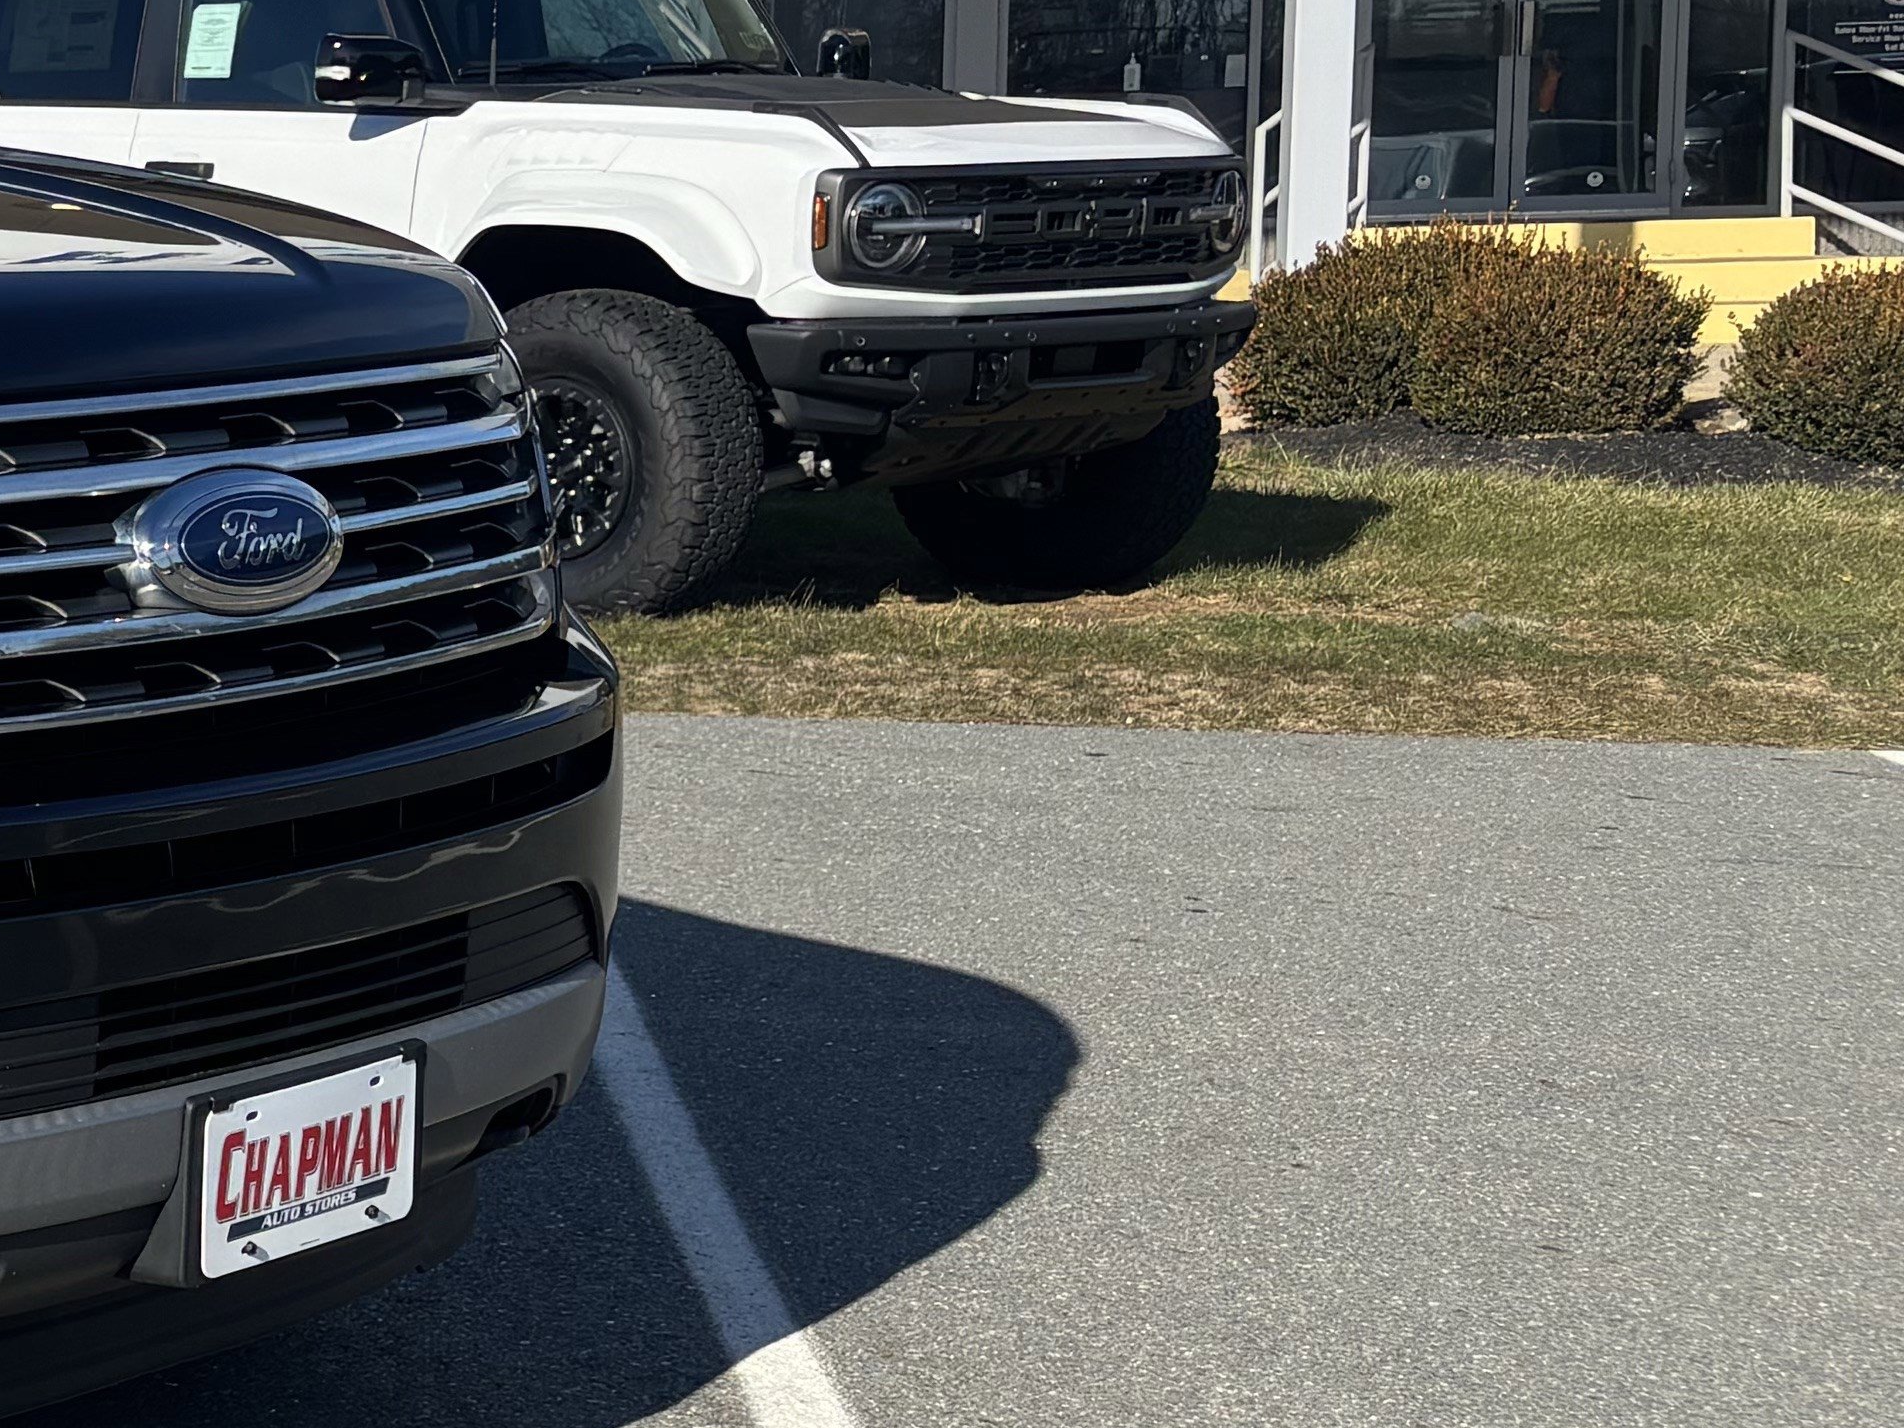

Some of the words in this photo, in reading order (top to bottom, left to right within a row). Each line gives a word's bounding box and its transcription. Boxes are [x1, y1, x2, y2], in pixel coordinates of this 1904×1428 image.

[218, 507, 306, 570] Ford
[215, 1094, 405, 1225] CHAPMAN
[261, 1205, 301, 1229] AUTO
[304, 1189, 358, 1217] STORES
